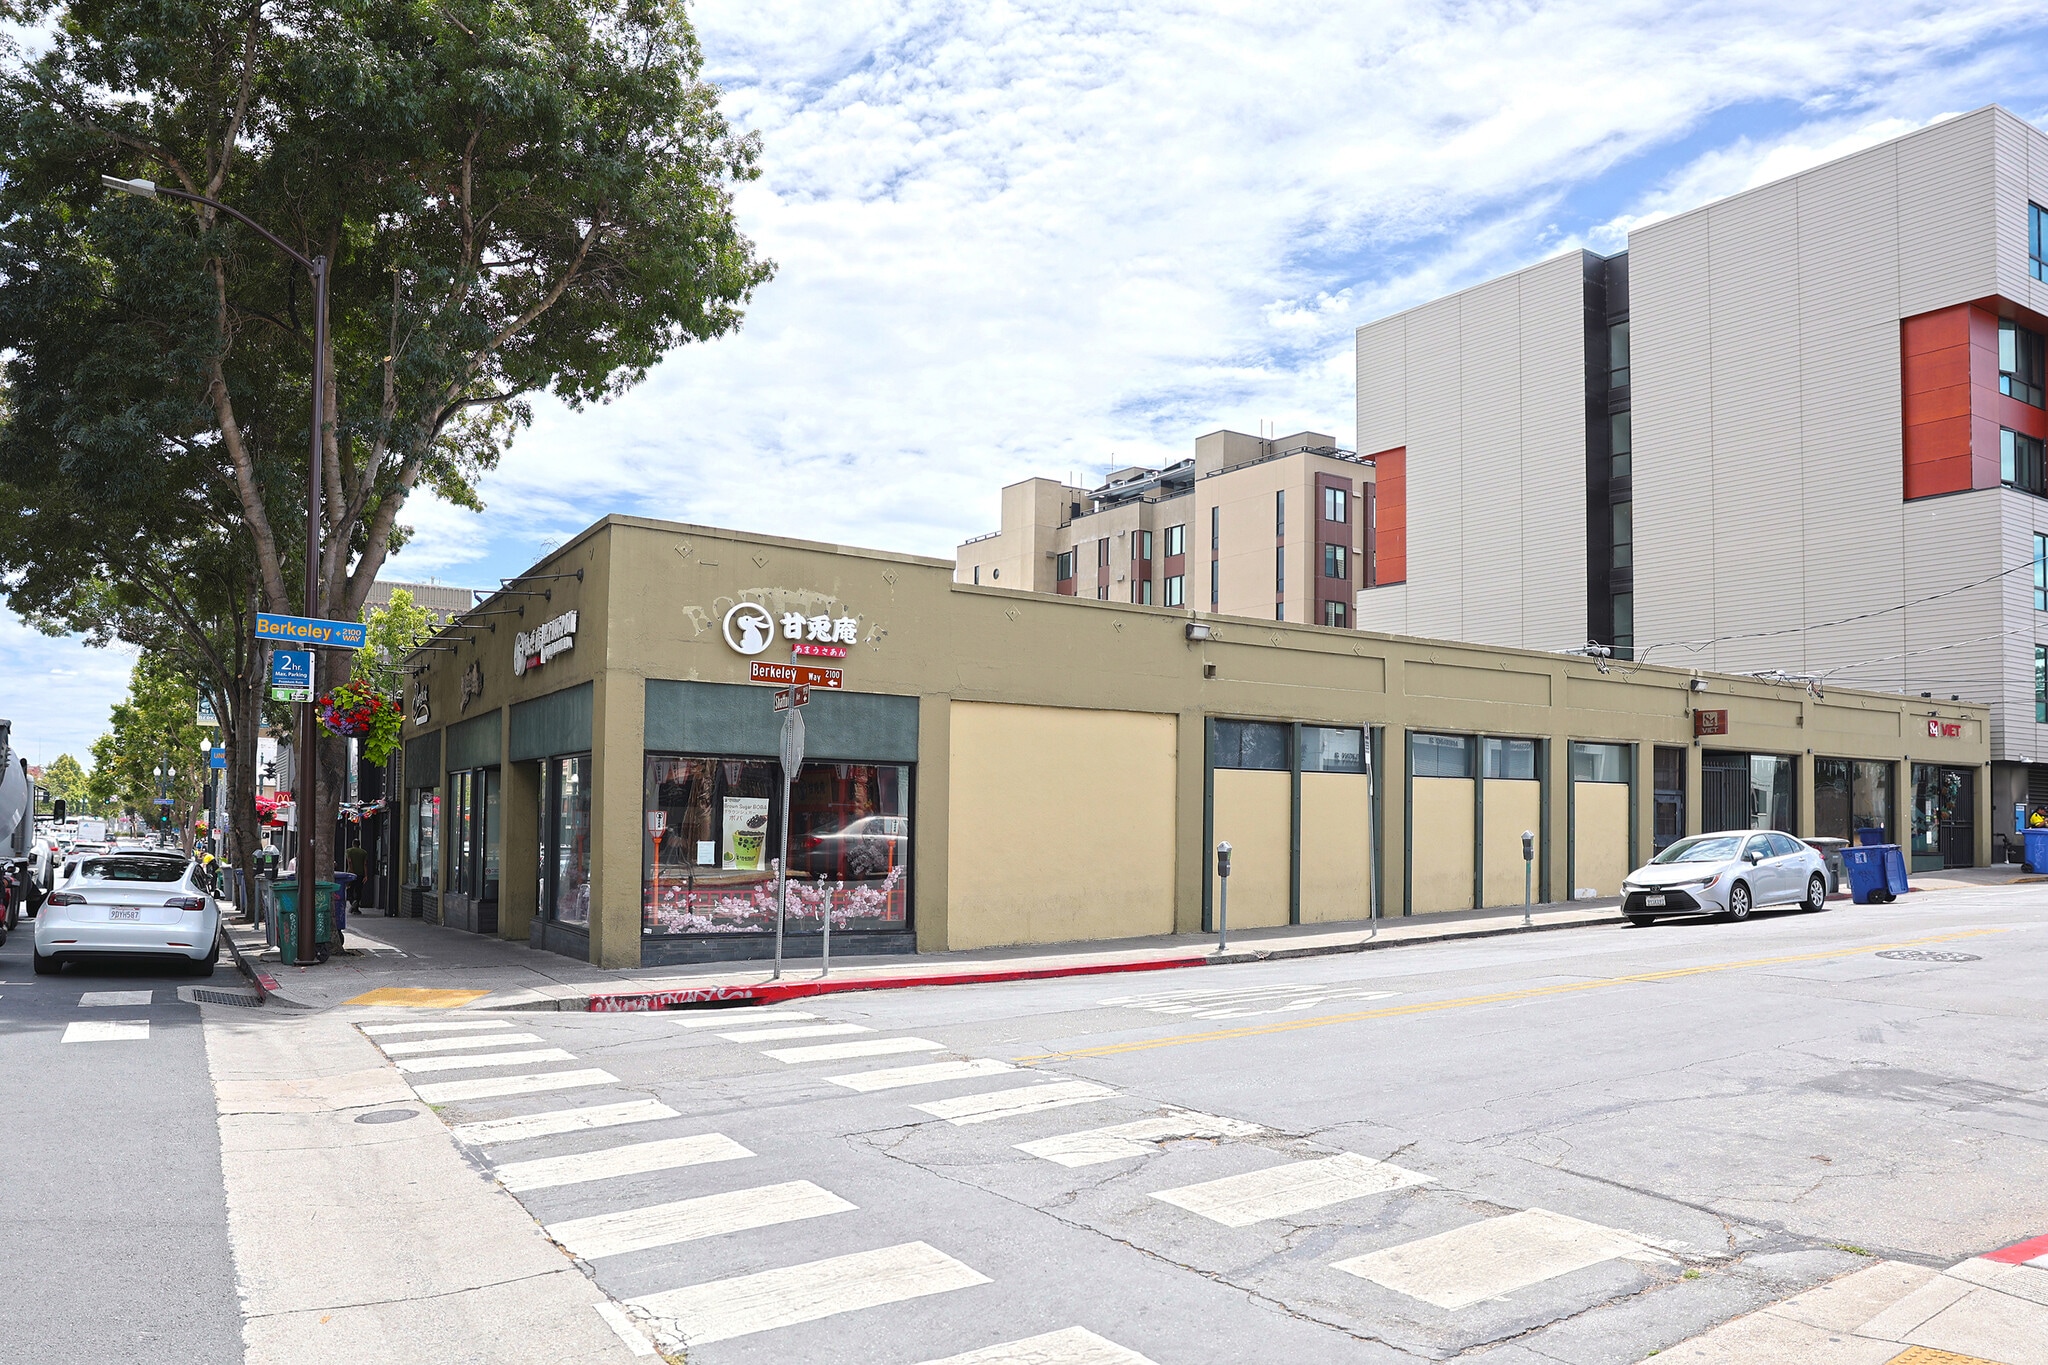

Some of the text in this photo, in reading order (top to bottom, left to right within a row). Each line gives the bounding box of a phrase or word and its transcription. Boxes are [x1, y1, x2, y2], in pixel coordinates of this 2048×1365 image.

[257, 619, 331, 641] Berkeley
[342, 628, 362, 636] 2100
[795, 645, 846, 657] あまうさあん
[281, 655, 303, 671] 2 hr.
[752, 663, 840, 683] Berkeley Way 2100
[1704, 713, 1717, 727] 84
[1930, 721, 1961, 737] 84 VIET
